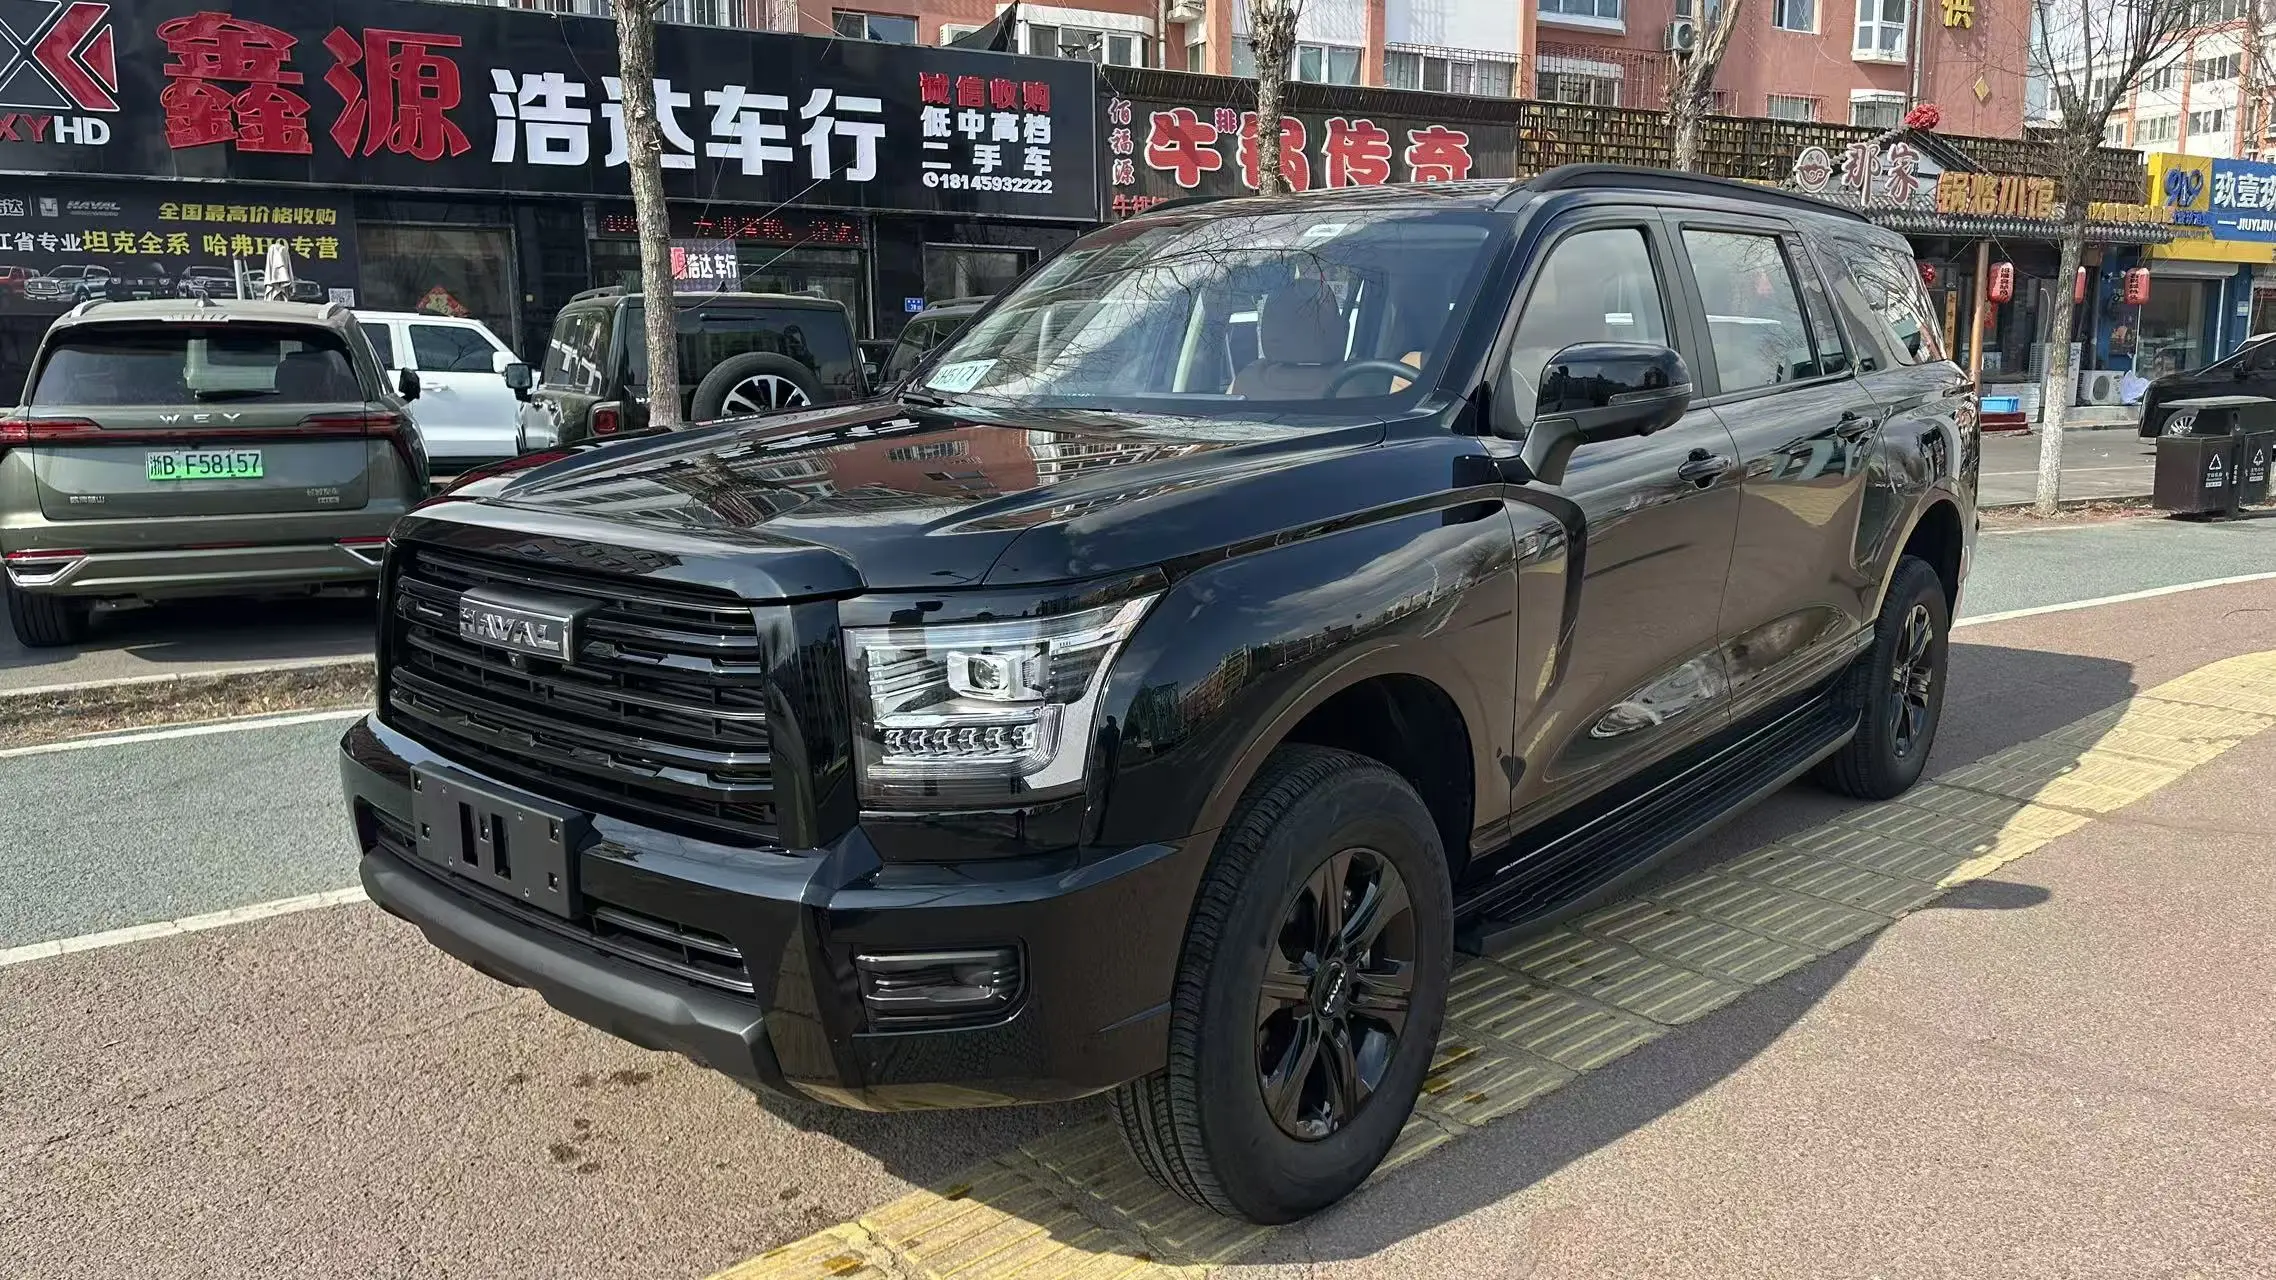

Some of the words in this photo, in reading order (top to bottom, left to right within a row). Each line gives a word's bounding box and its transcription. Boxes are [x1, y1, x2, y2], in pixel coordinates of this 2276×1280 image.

[156, 12, 471, 161] 鑫源
[919, 72, 1050, 112] 诚信收购
[920, 105, 1051, 144] 低中高档
[1108, 98, 1135, 187] 佰福源
[922, 141, 1052, 176] 二手车
[1841, 142, 1920, 207] 那家
[940, 173, 1053, 194] 18145932222
[66, 200, 121, 211] HAVAL
[158, 202, 338, 225] 全国最高价格收购
[159, 412, 242, 425] WEY
[149, 455, 175, 476] 浙B
[185, 453, 260, 475] F58157
[460, 607, 561, 652] HAVAL
